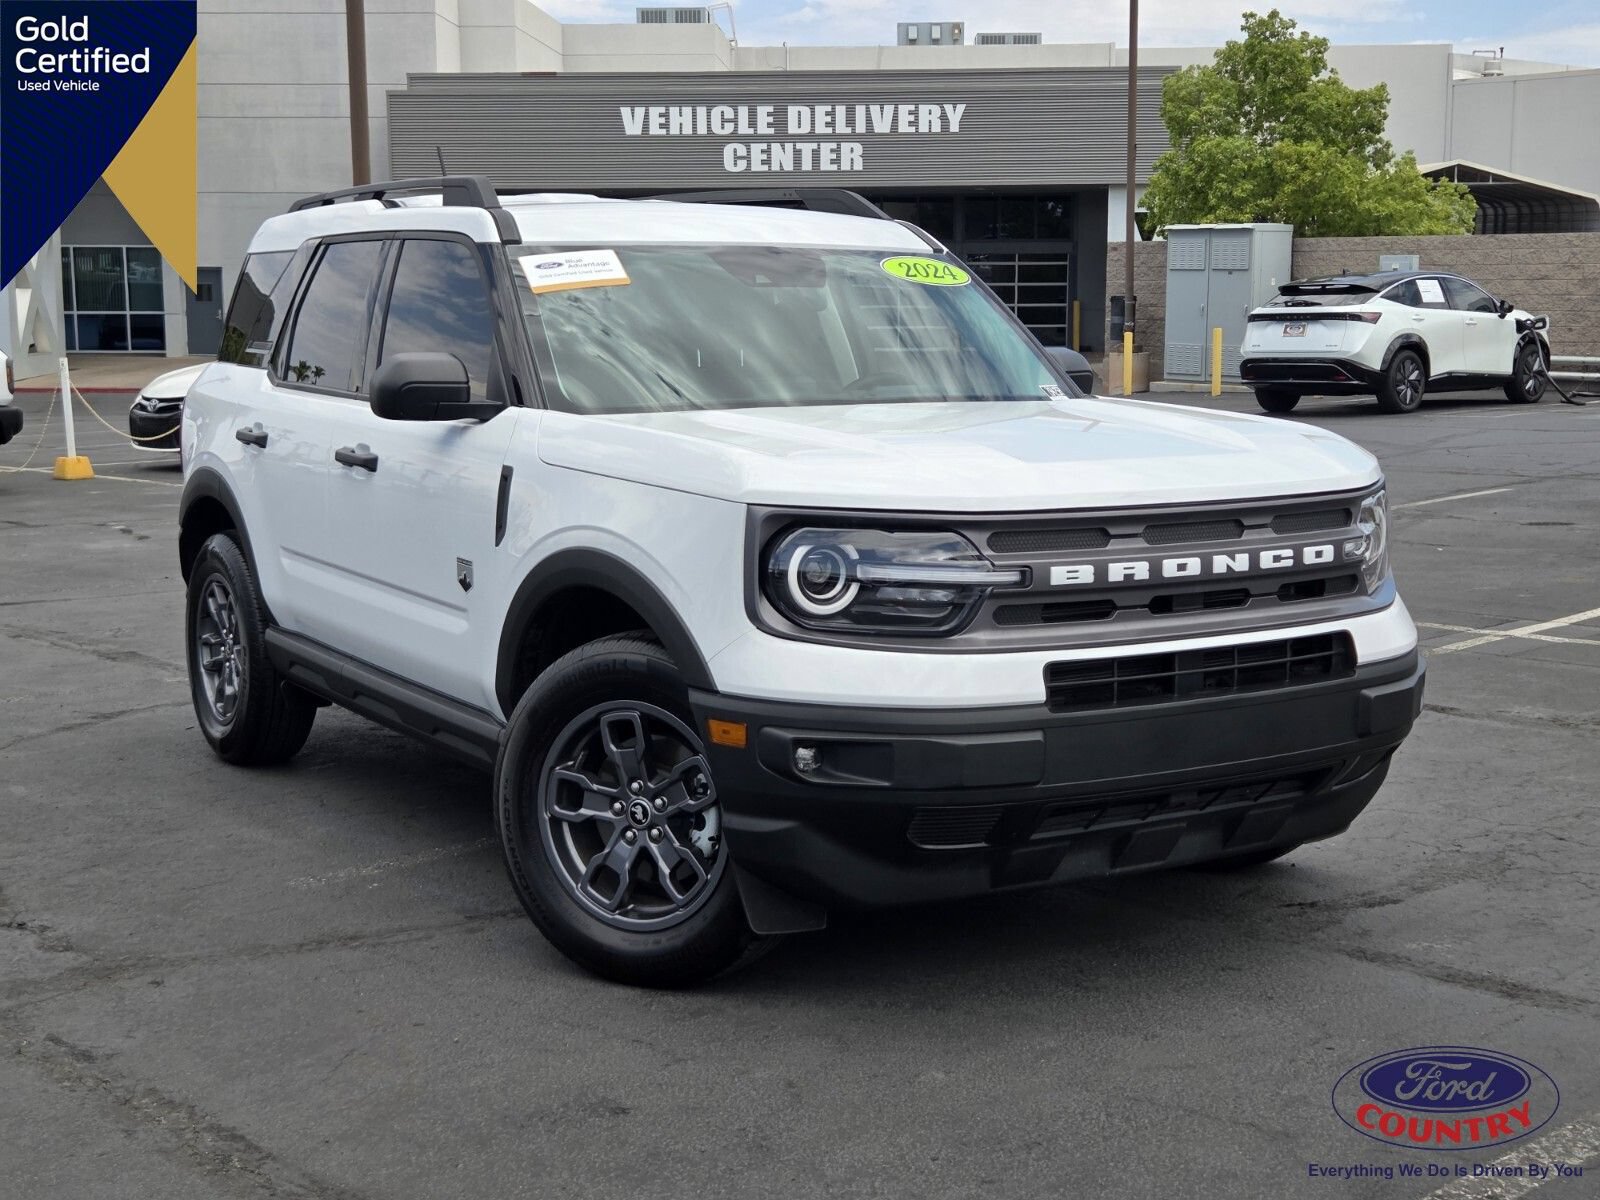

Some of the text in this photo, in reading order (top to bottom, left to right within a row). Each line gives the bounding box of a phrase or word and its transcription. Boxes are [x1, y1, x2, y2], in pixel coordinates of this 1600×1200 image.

[620, 103, 966, 135] VEHICLE DELIVERY
[723, 142, 863, 172] CENTER
[898, 262, 958, 280] 2024
[1050, 544, 1334, 585] BRONCO
